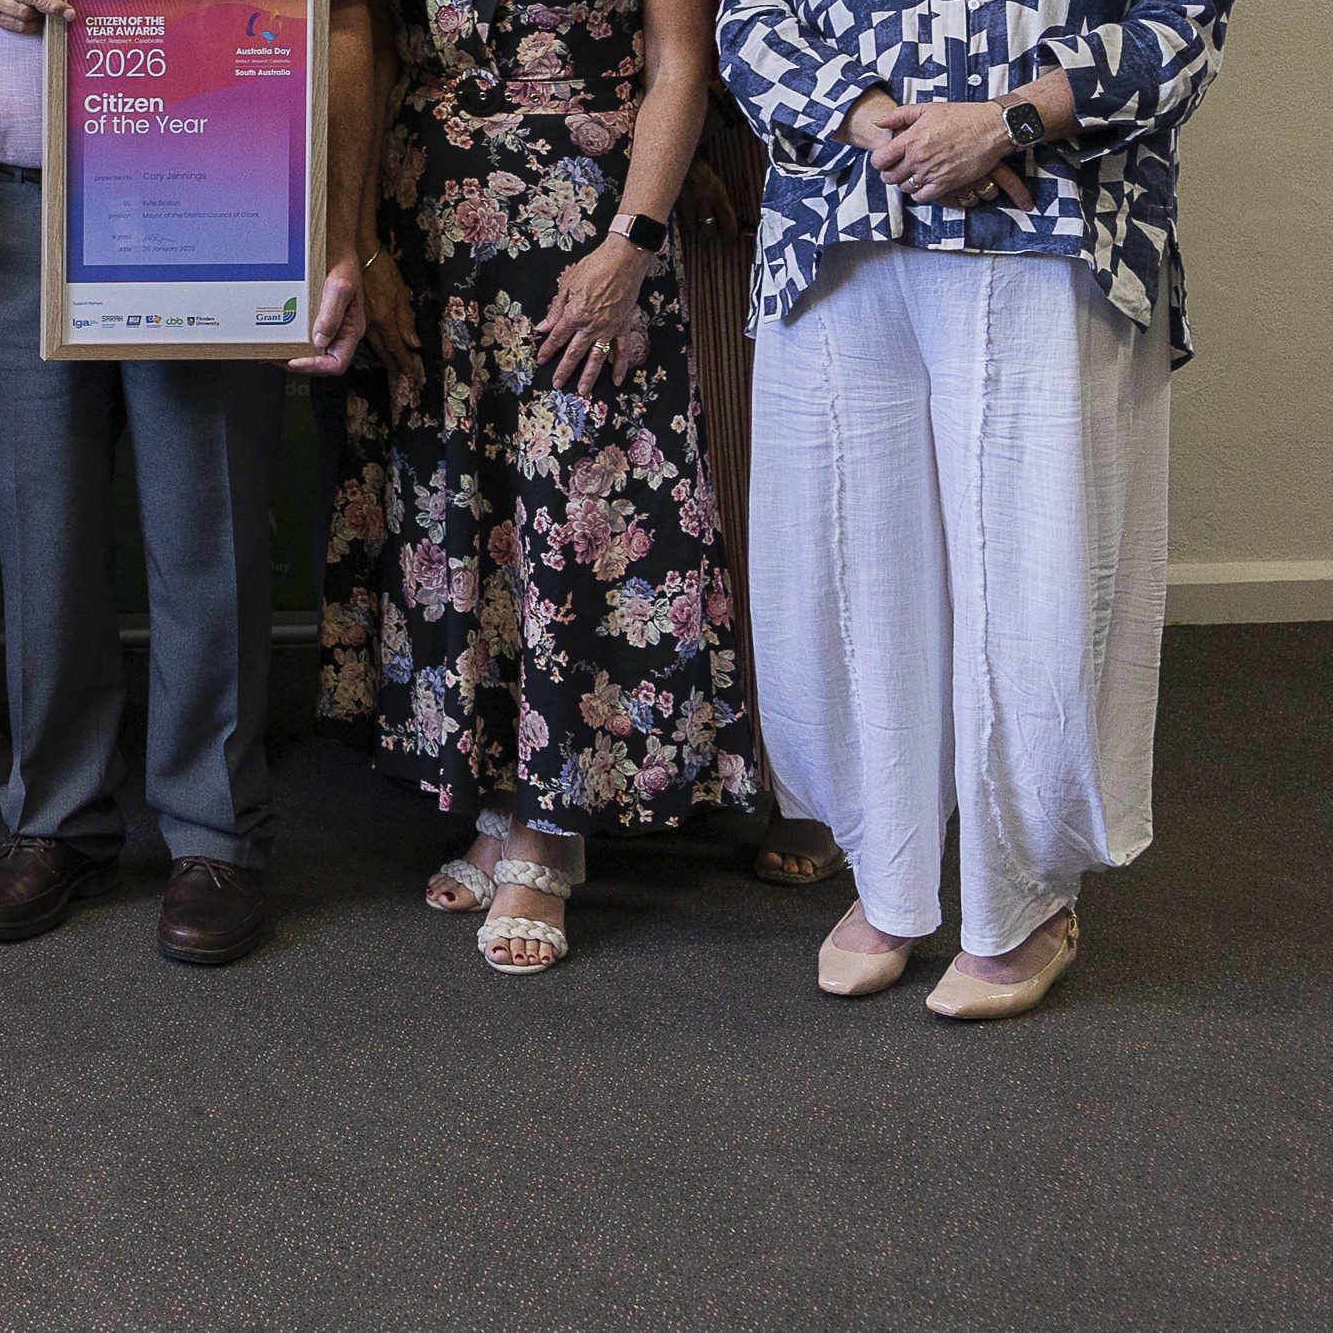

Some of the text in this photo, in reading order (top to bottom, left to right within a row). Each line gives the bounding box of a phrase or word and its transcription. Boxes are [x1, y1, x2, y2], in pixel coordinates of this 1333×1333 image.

[85, 16, 165, 26] CITIZEN OF THE
[86, 26, 165, 36] YEAR AWARDS
[236, 48, 291, 56] Australia Day
[85, 49, 167, 77] 2026
[84, 92, 164, 113] Citizen
[84, 115, 208, 135] of the Year
[143, 172, 207, 182] Cary Jennings
[256, 313, 281, 321] Grant
